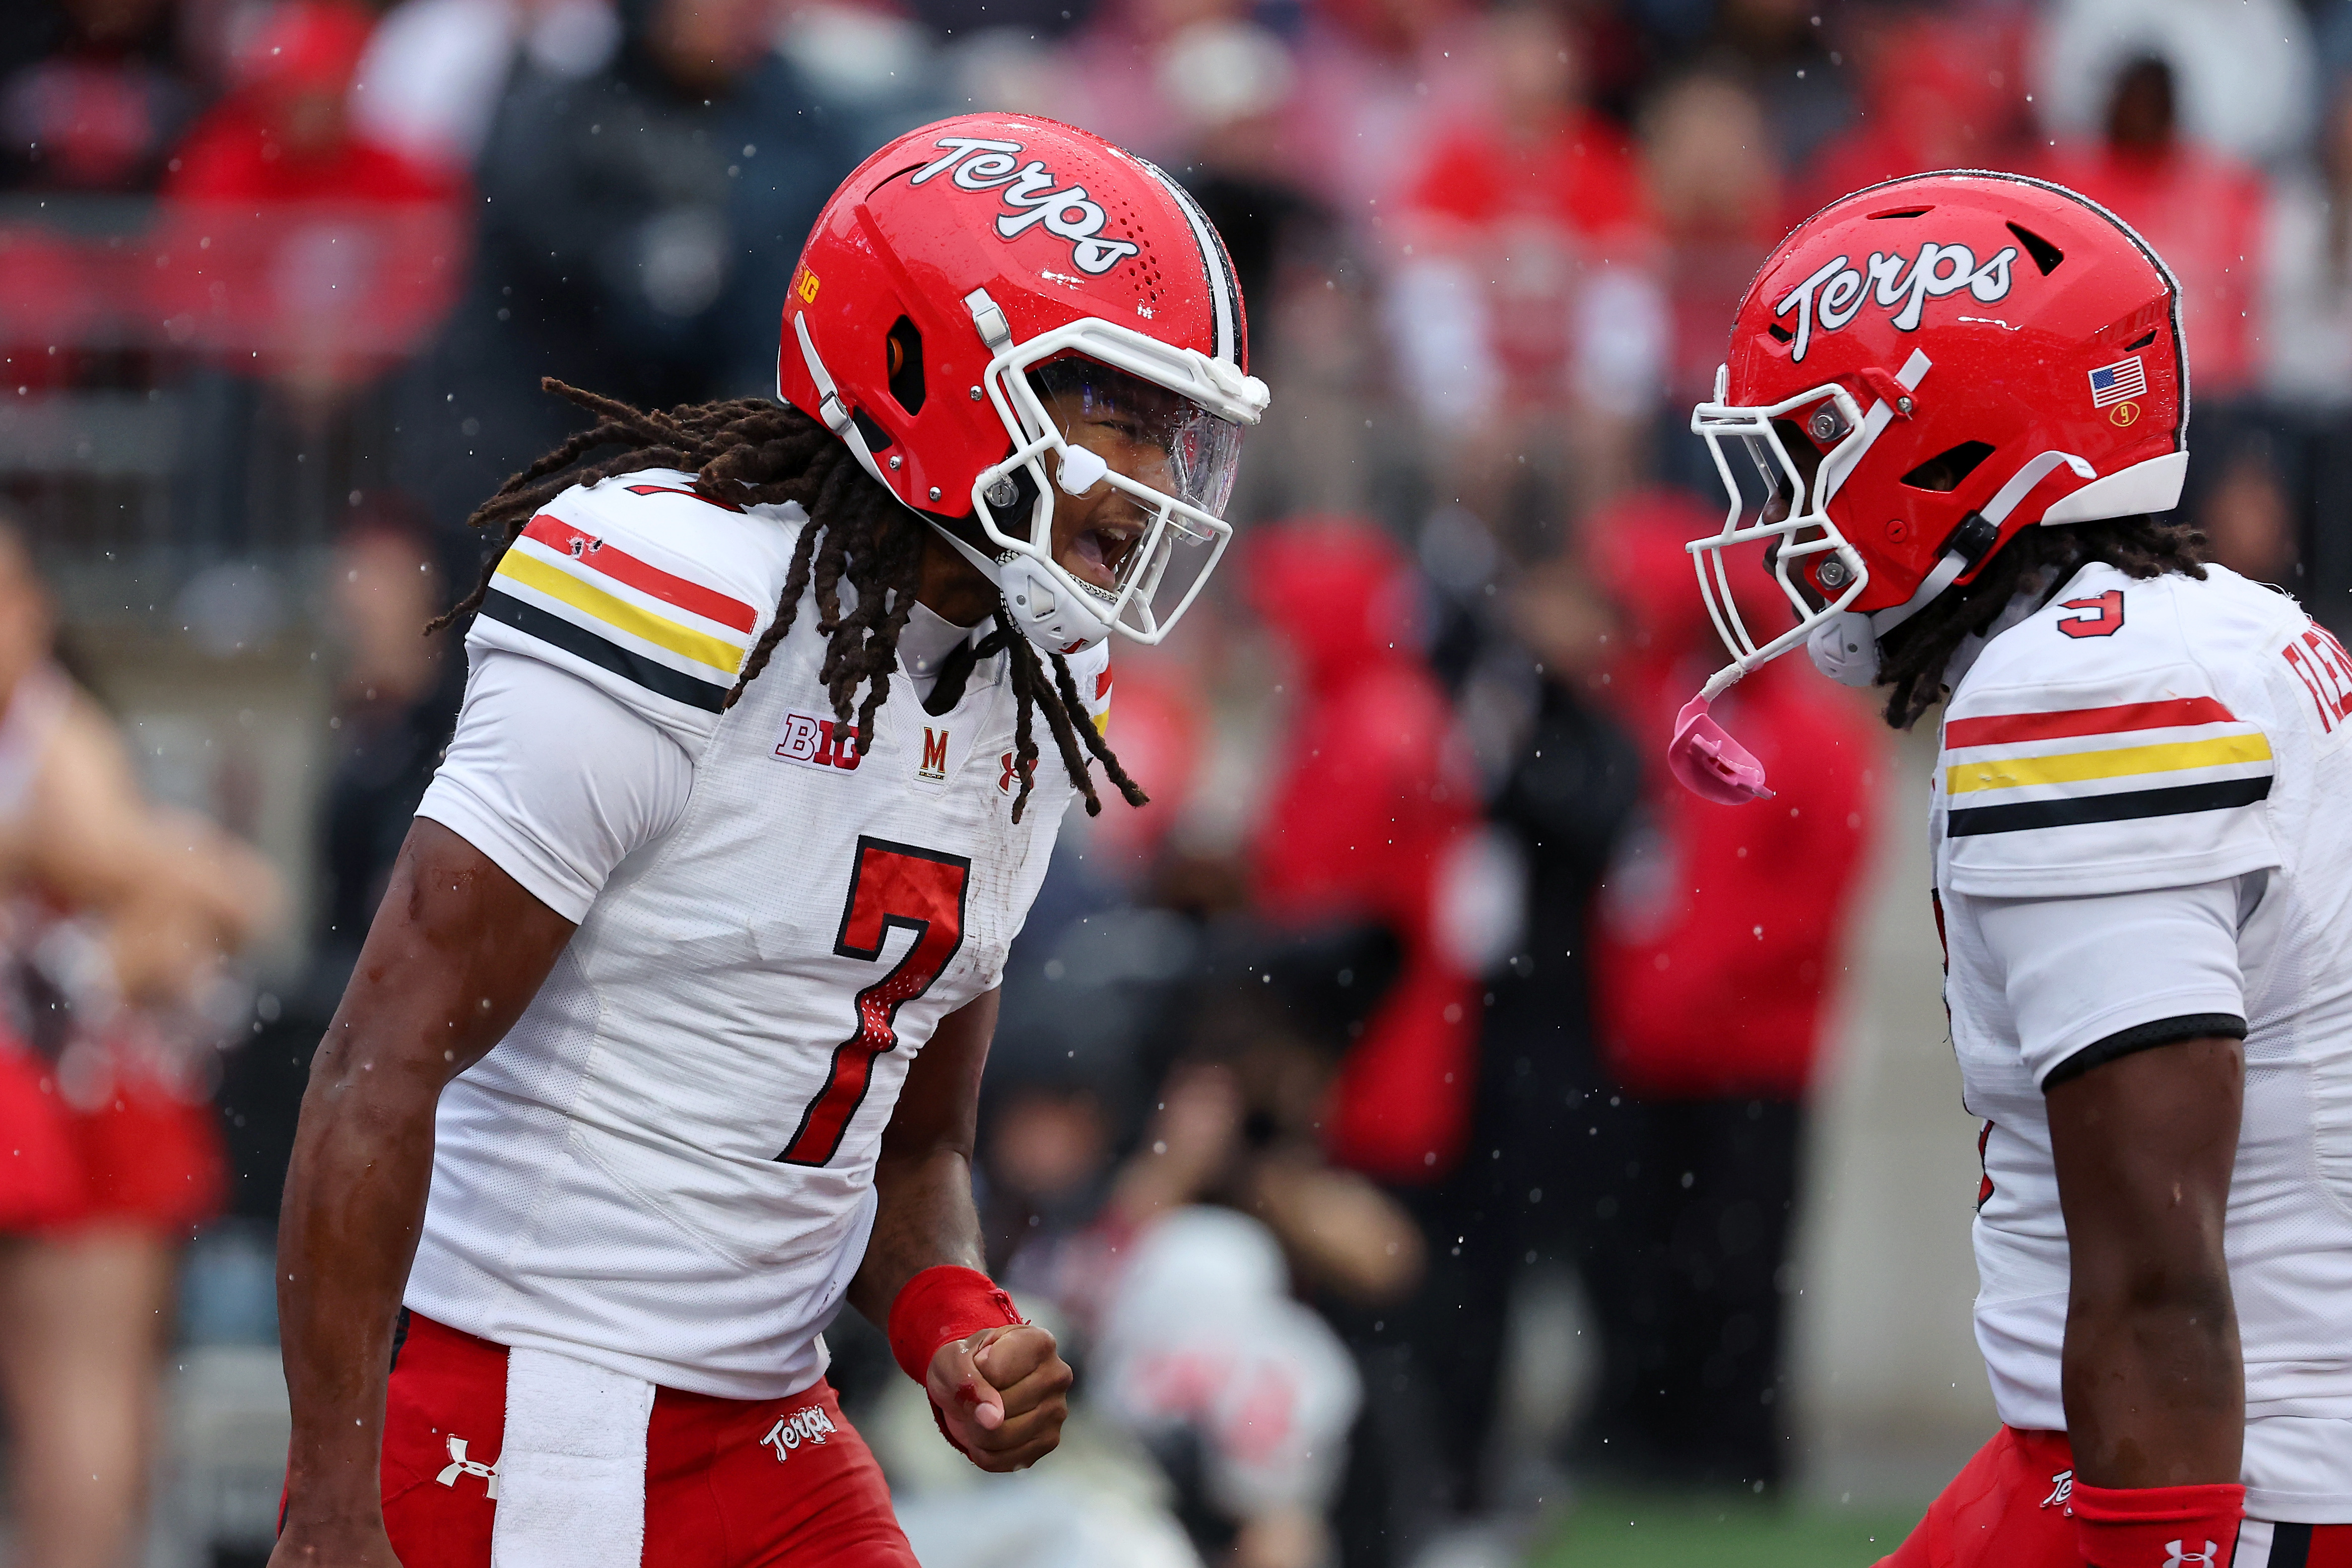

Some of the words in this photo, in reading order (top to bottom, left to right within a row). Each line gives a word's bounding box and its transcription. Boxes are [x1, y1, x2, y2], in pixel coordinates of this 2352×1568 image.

[910, 136, 1140, 275] Terps
[1776, 242, 2018, 364] Terps
[920, 726, 949, 774] M
[773, 834, 972, 1168] 7
[761, 1405, 837, 1462] Terps
